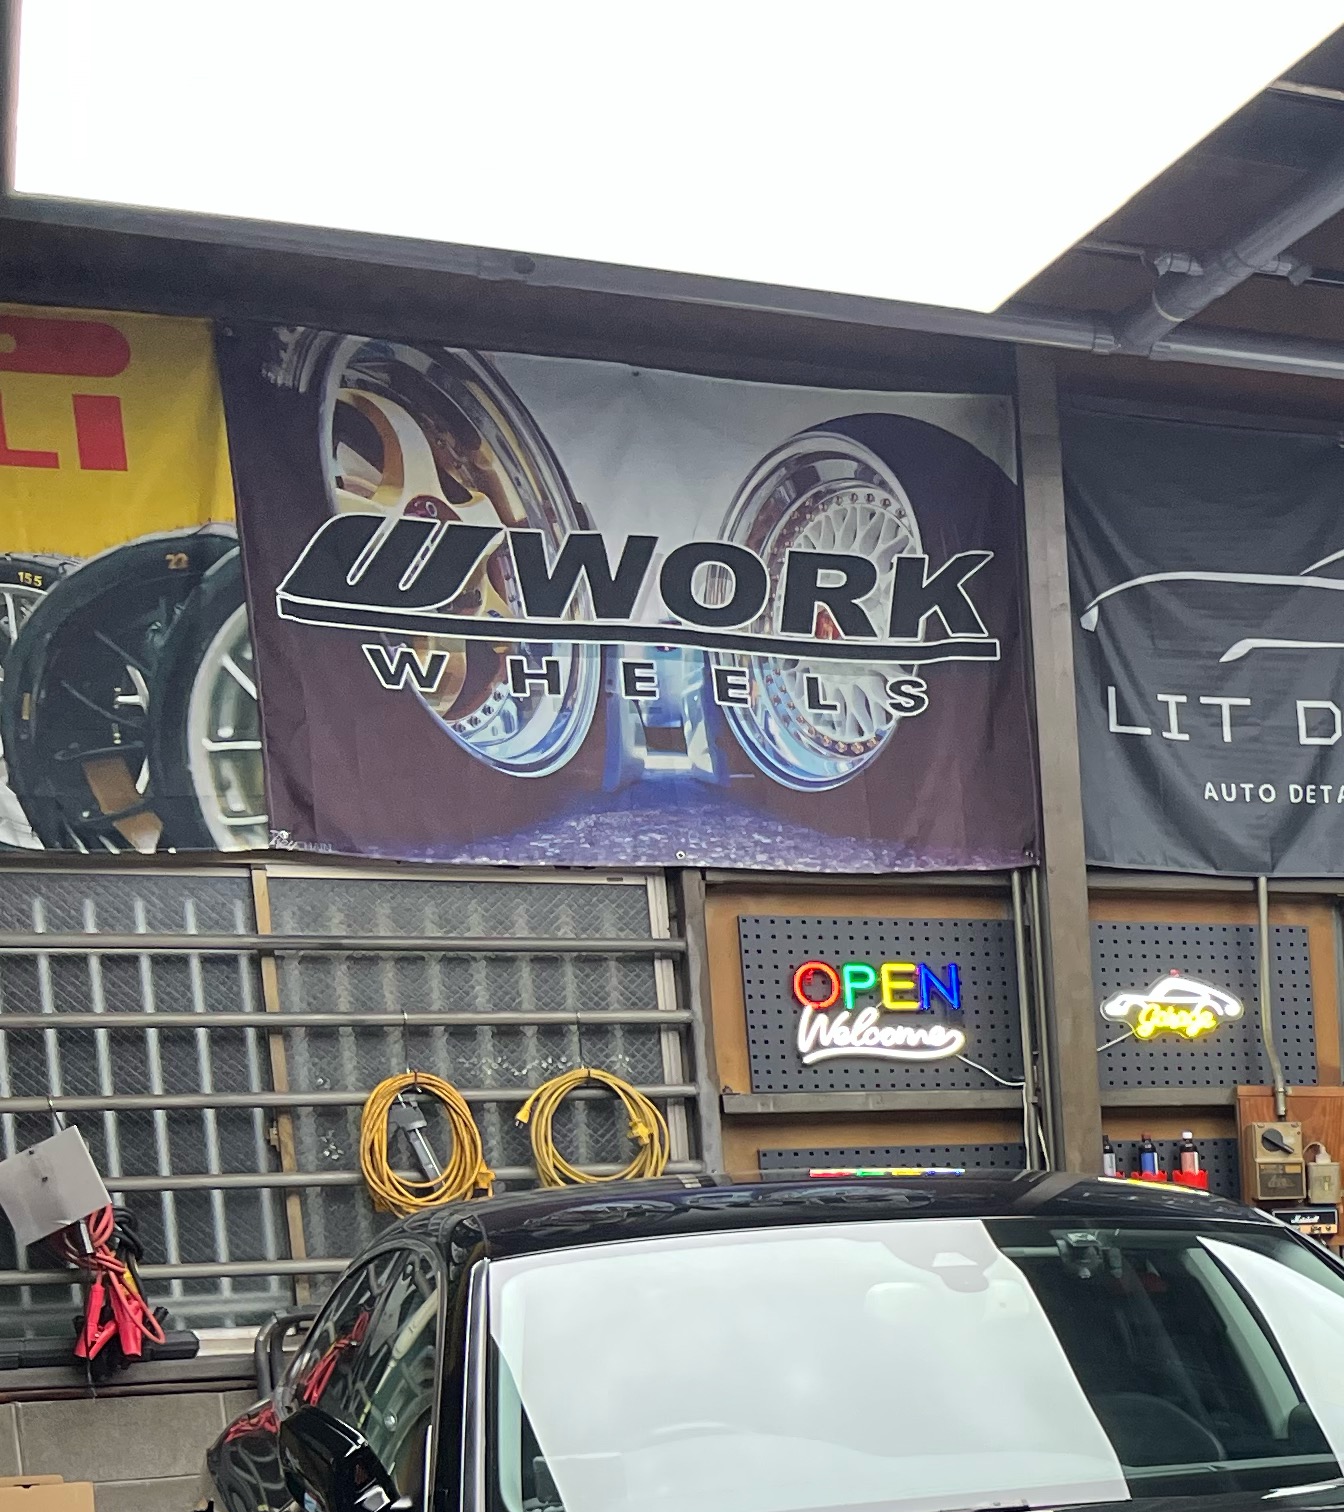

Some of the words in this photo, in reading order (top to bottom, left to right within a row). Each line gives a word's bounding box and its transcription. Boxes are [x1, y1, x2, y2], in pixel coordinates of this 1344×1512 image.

[504, 527, 997, 645] WORK
[362, 643, 931, 718] WHEELS
[1107, 685, 1252, 743] LIT
[1203, 781, 1277, 804] AUTO
[792, 960, 962, 1011] OPEN
